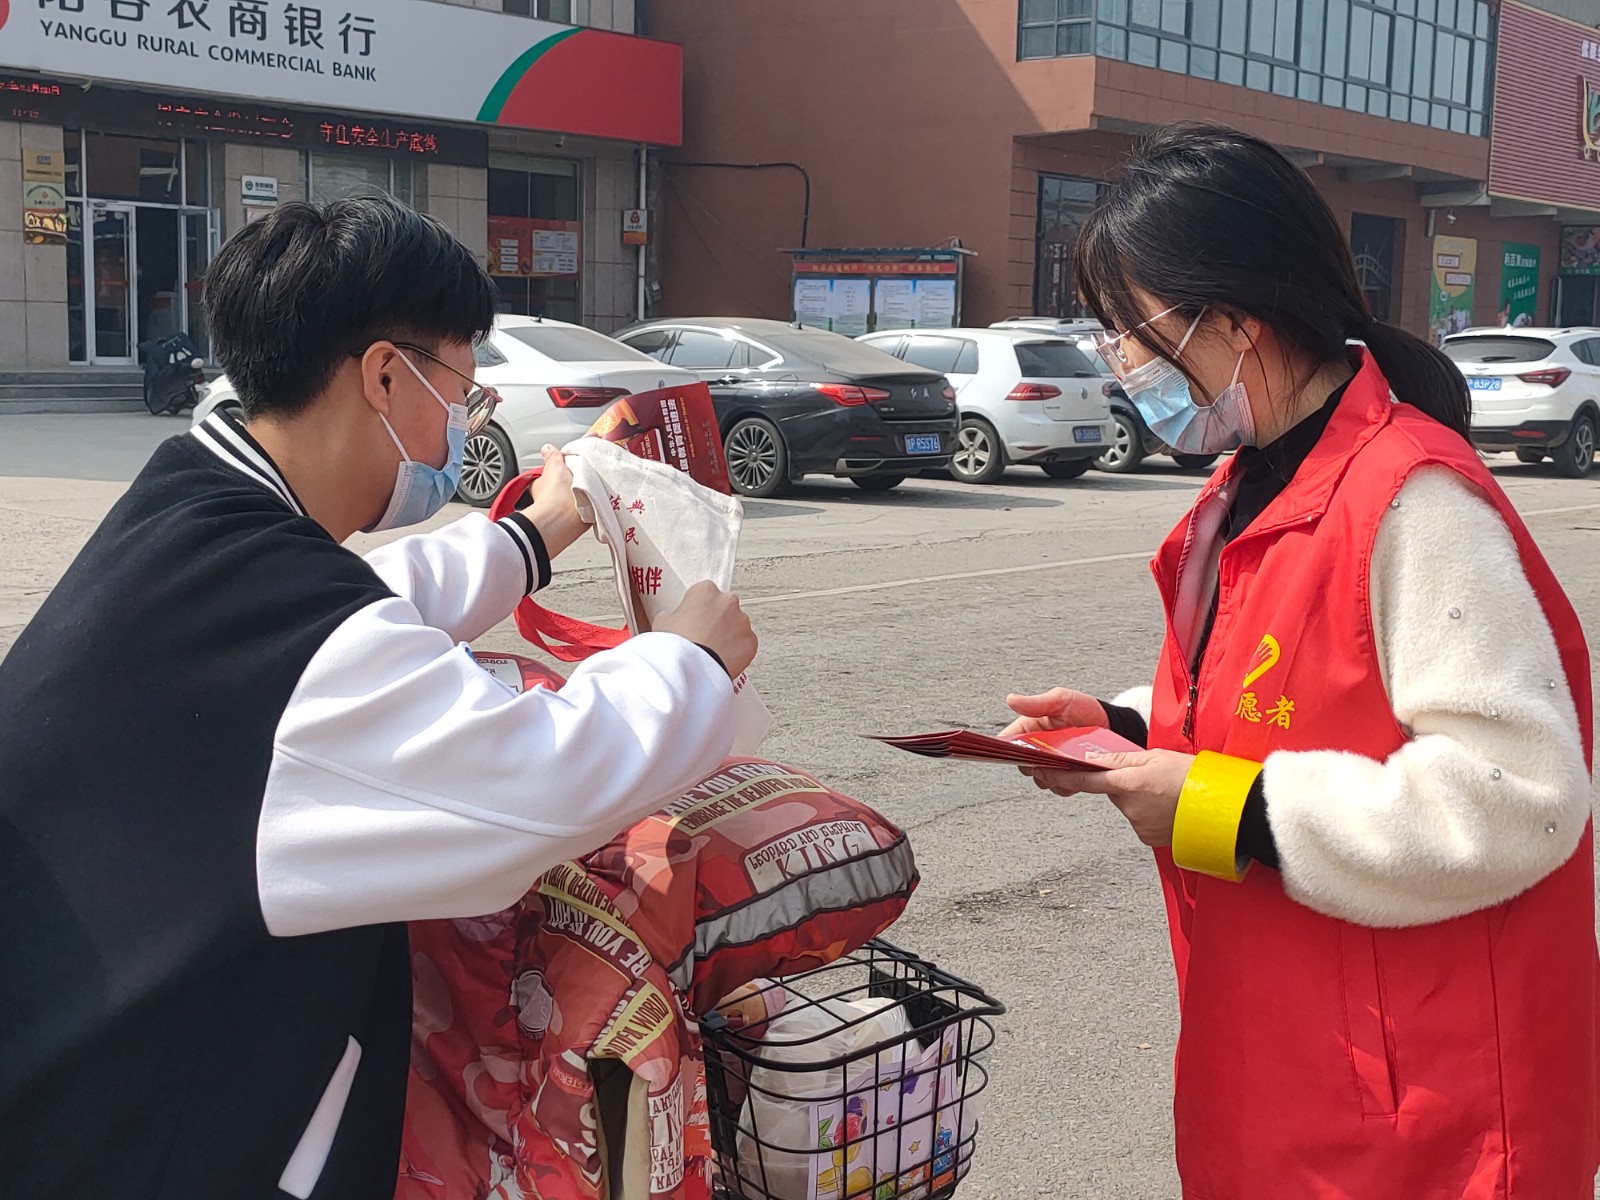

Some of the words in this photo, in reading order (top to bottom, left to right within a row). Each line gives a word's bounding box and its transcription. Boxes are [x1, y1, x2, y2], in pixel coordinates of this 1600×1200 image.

[38, 0, 376, 56] 谷农商银行
[40, 19, 127, 47] YANGGU
[137, 34, 199, 57] RURAL
[208, 45, 325, 75] COMMERCIAL
[332, 61, 377, 82] BANK
[668, 398, 690, 475] 庭教育促进法
[691, 774, 740, 796] YOU
[583, 920, 627, 957] YOU
